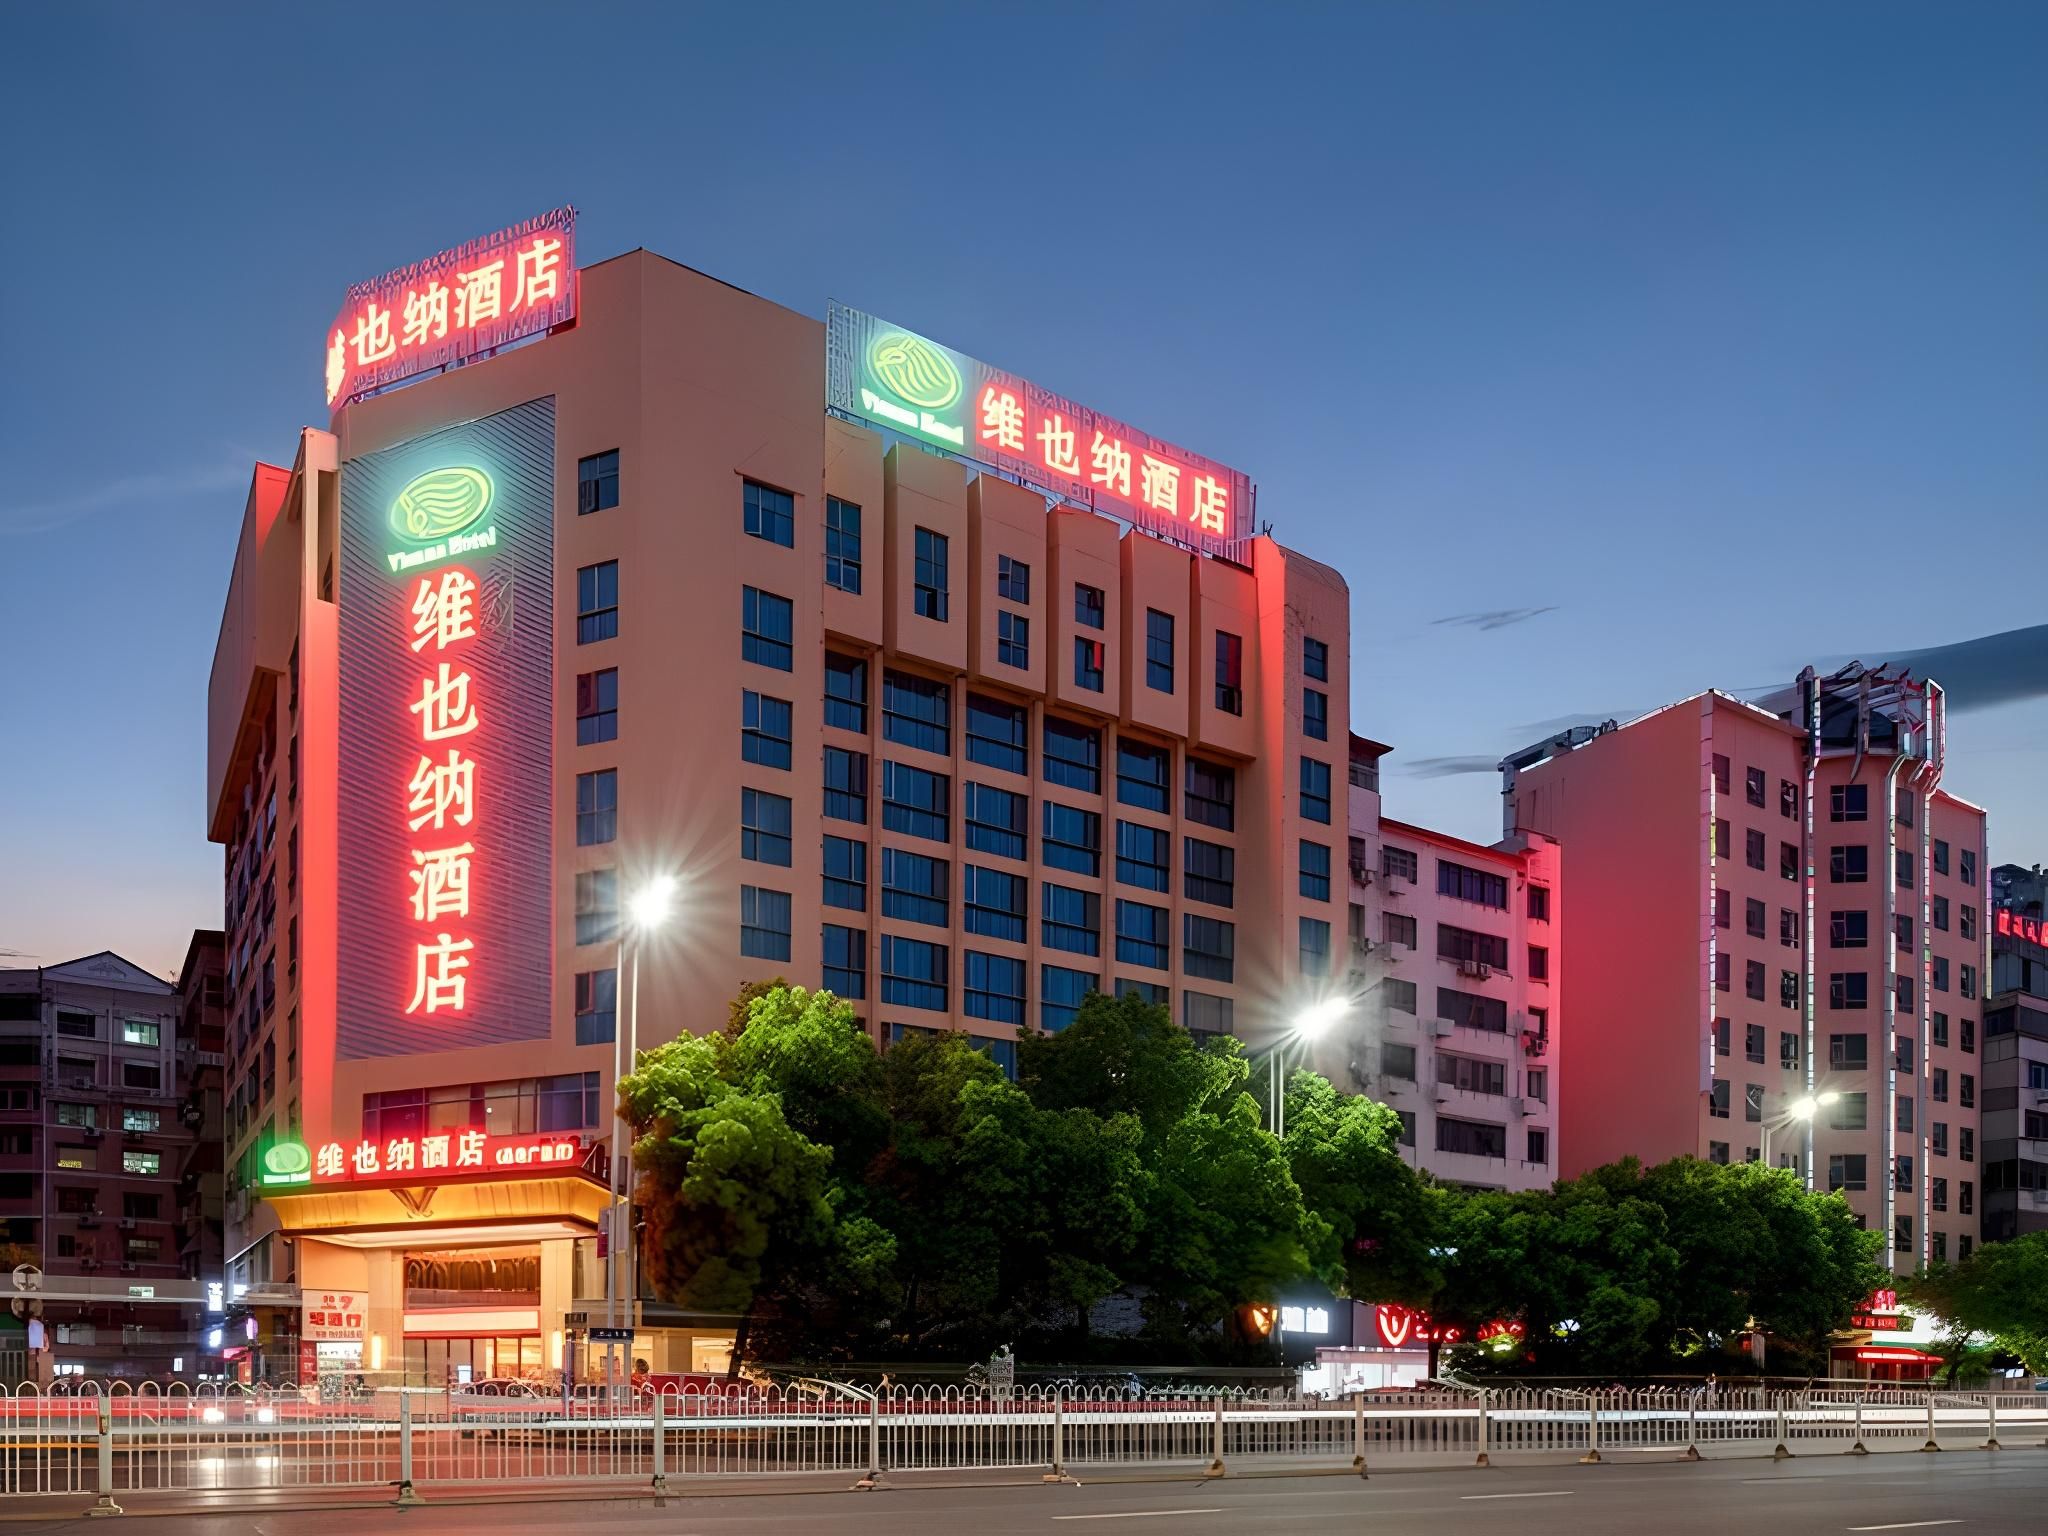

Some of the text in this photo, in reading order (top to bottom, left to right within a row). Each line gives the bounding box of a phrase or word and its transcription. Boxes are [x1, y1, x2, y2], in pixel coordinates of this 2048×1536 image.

[980, 387, 1228, 534] 维也纳酒店
[406, 570, 479, 1014] 维也纳酒店
[316, 1130, 487, 1176] 维也纳酒店
